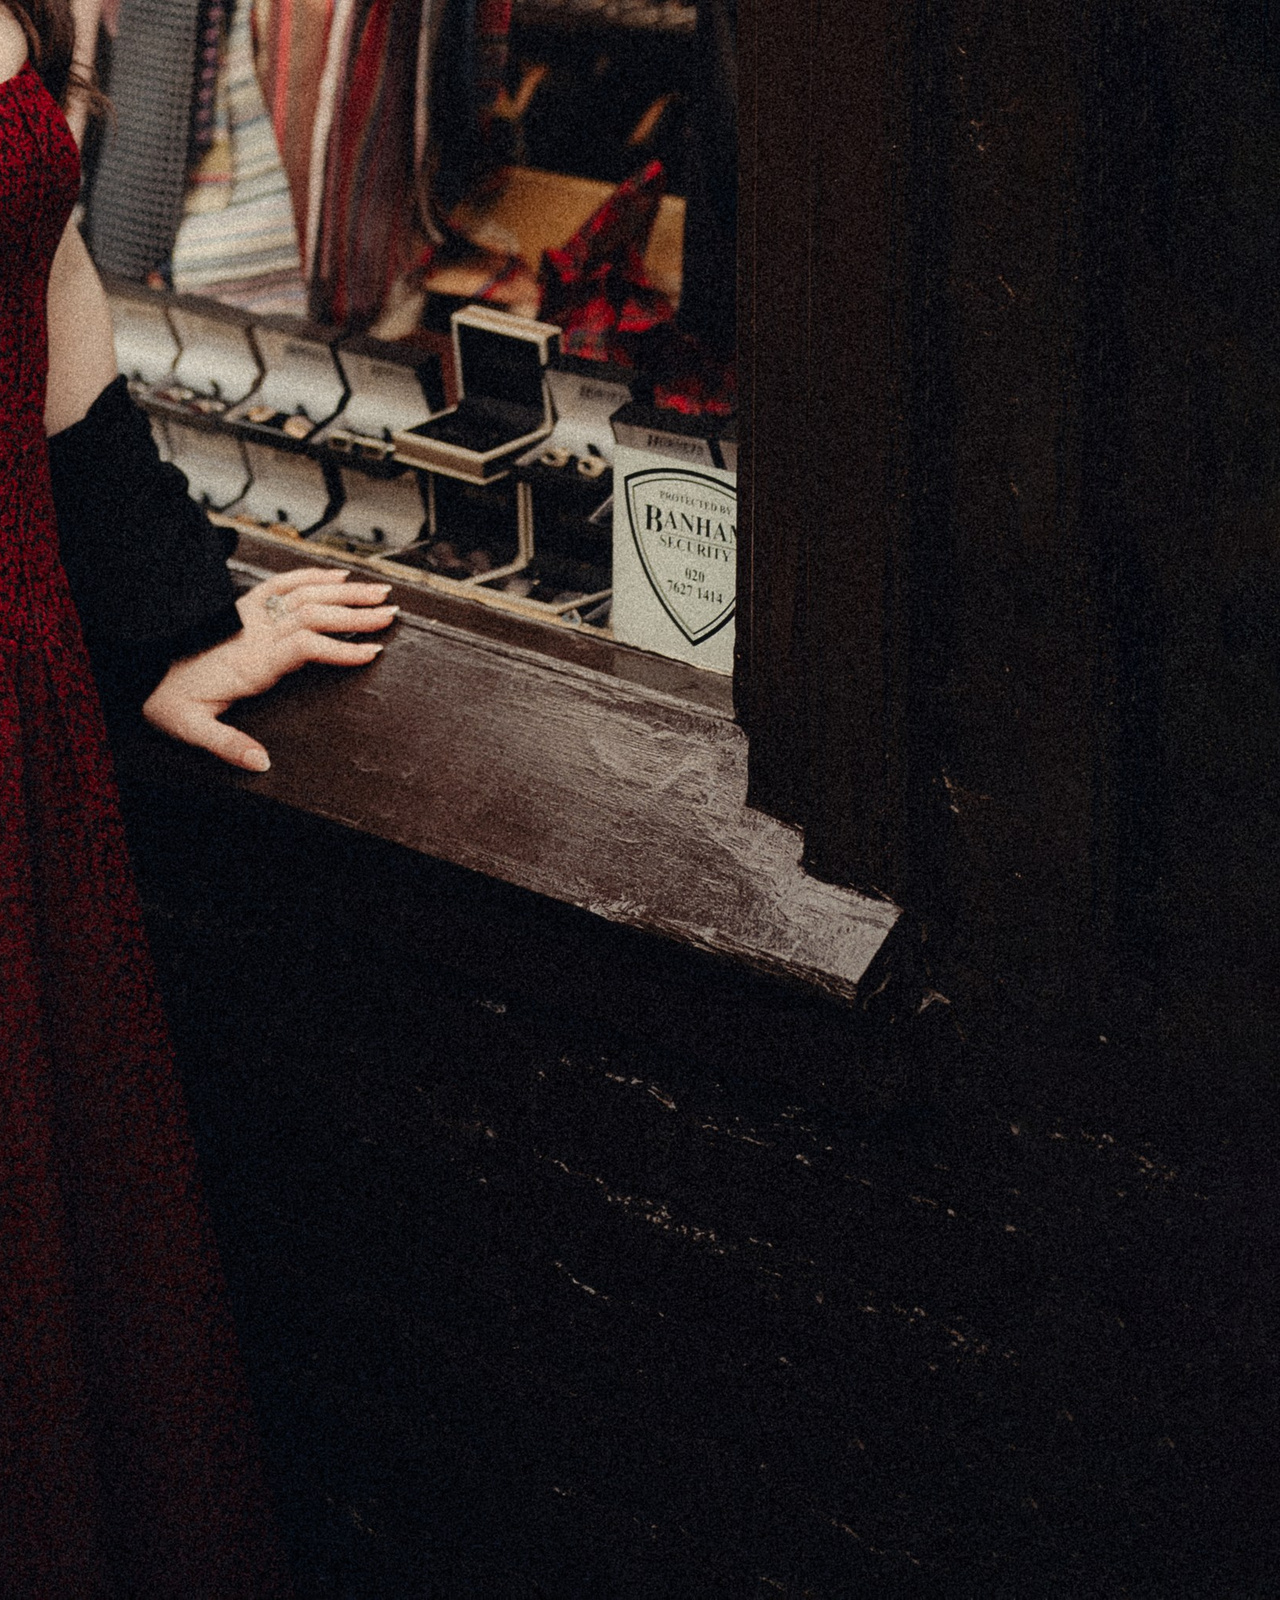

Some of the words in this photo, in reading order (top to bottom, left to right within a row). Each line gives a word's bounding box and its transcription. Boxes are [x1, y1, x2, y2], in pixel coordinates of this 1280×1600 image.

[660, 490, 718, 512] PROTECTED
[720, 504, 732, 516] BY
[660, 534, 732, 562] SECURITY
[685, 567, 705, 583] 020
[667, 579, 693, 597] 7627
[698, 587, 723, 604] 1414
